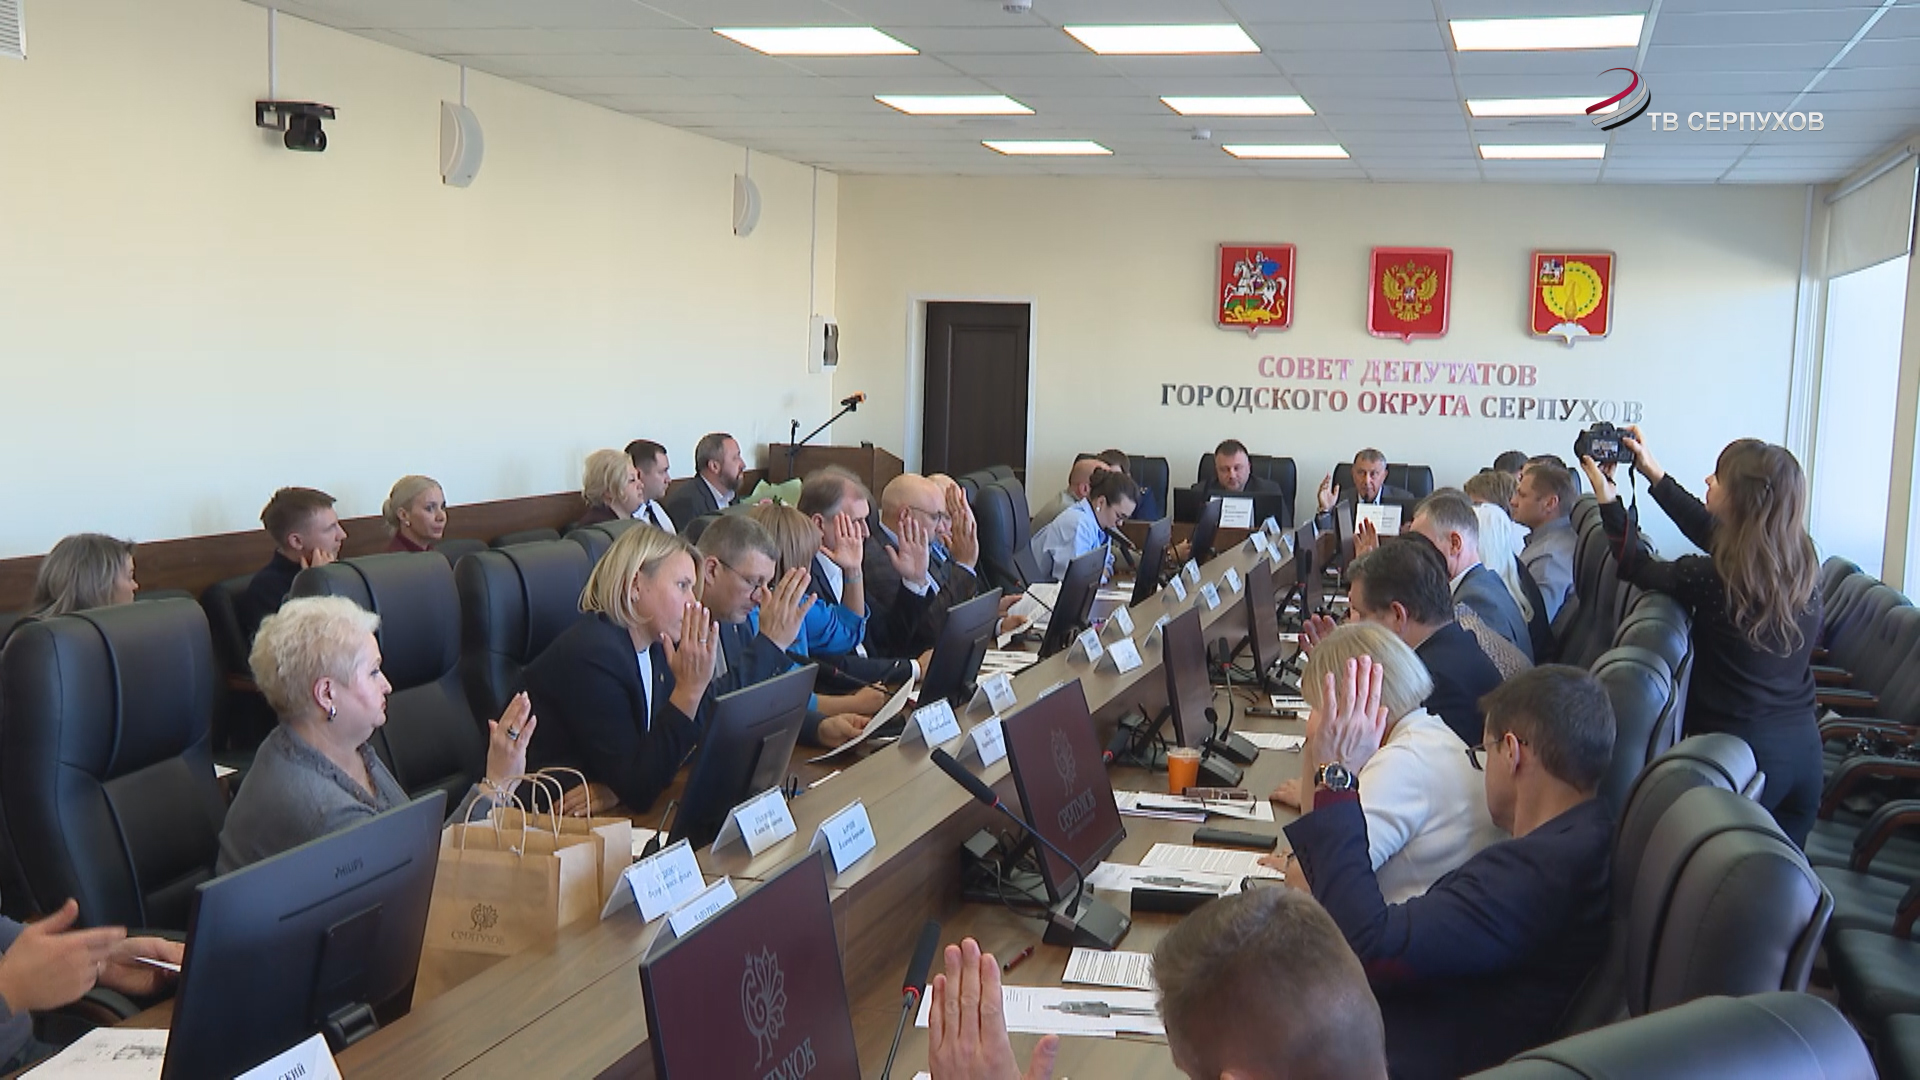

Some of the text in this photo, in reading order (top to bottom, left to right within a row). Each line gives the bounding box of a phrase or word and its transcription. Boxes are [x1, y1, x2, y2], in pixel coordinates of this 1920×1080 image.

[1258, 355, 1537, 387] СОВЕТ ДЕПУТАТОВ
[1161, 383, 1643, 424] ГОРОДСКОГО ОКРУГА СЕРПУХОВ
